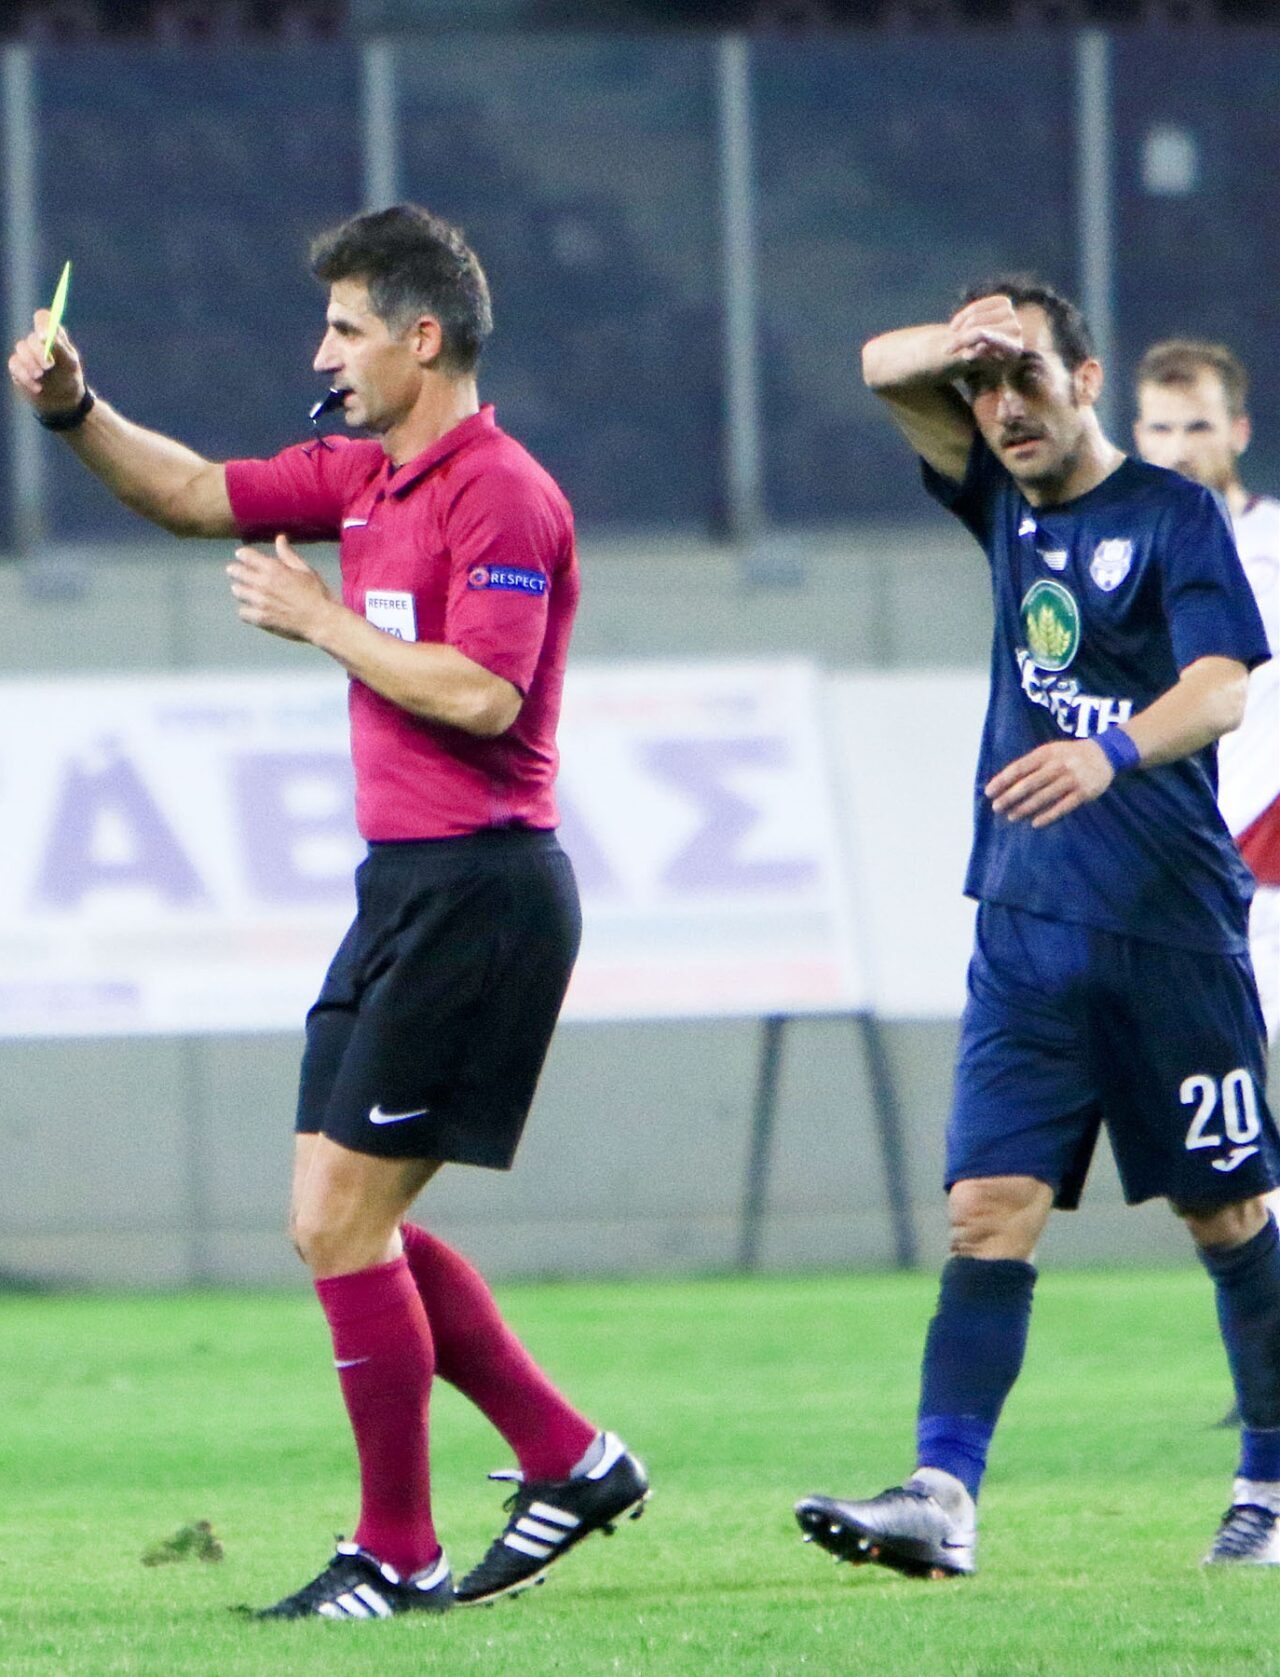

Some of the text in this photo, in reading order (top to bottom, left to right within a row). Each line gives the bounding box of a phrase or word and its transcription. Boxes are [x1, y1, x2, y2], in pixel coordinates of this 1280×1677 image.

[490, 573, 545, 591] RESPECT
[368, 598, 408, 610] REFEREE
[1179, 1068, 1261, 1150] 20
